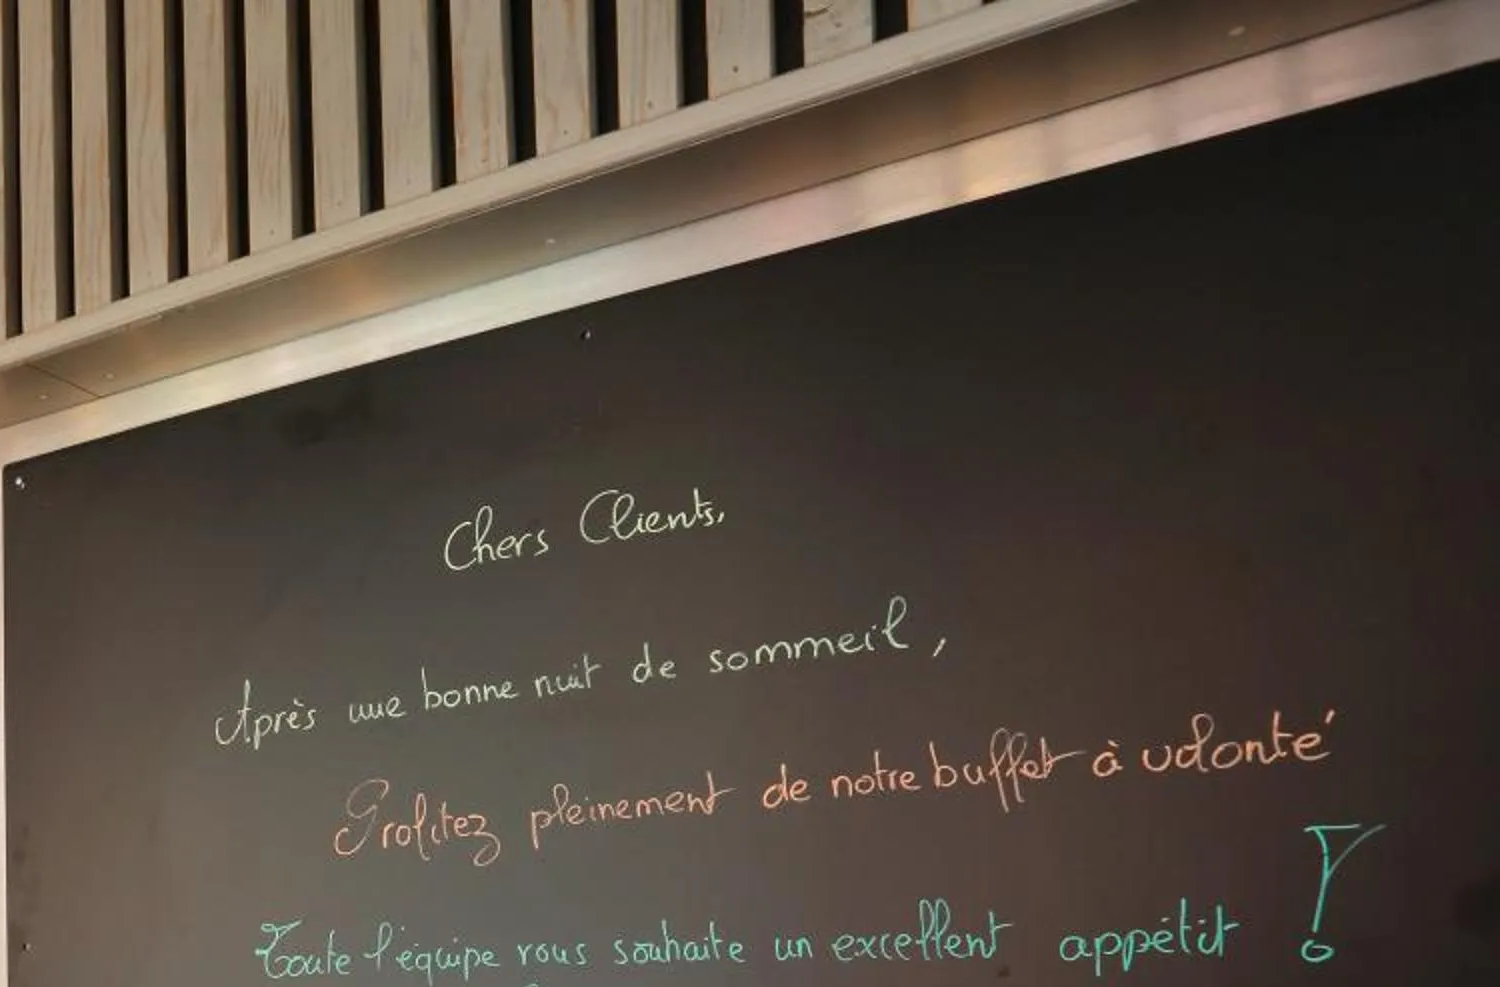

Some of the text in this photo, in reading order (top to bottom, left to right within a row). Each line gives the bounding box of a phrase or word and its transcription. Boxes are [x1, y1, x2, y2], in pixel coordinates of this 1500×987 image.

[444, 505, 550, 571] Chers
[214, 679, 317, 751] Après
[348, 696, 407, 724] une
[421, 667, 520, 711] bonne
[534, 653, 603, 699] nuit
[631, 641, 678, 684] de
[530, 770, 736, 851] pleinement
[761, 763, 812, 809] de
[830, 750, 921, 799] notre
[928, 727, 1085, 813] buffet
[1091, 740, 1124, 778] à
[255, 919, 352, 979] Toute
[612, 920, 747, 965] souhaite
[774, 937, 814, 961] un
[831, 898, 1013, 962] excellent
[1059, 897, 1240, 977] appétit
